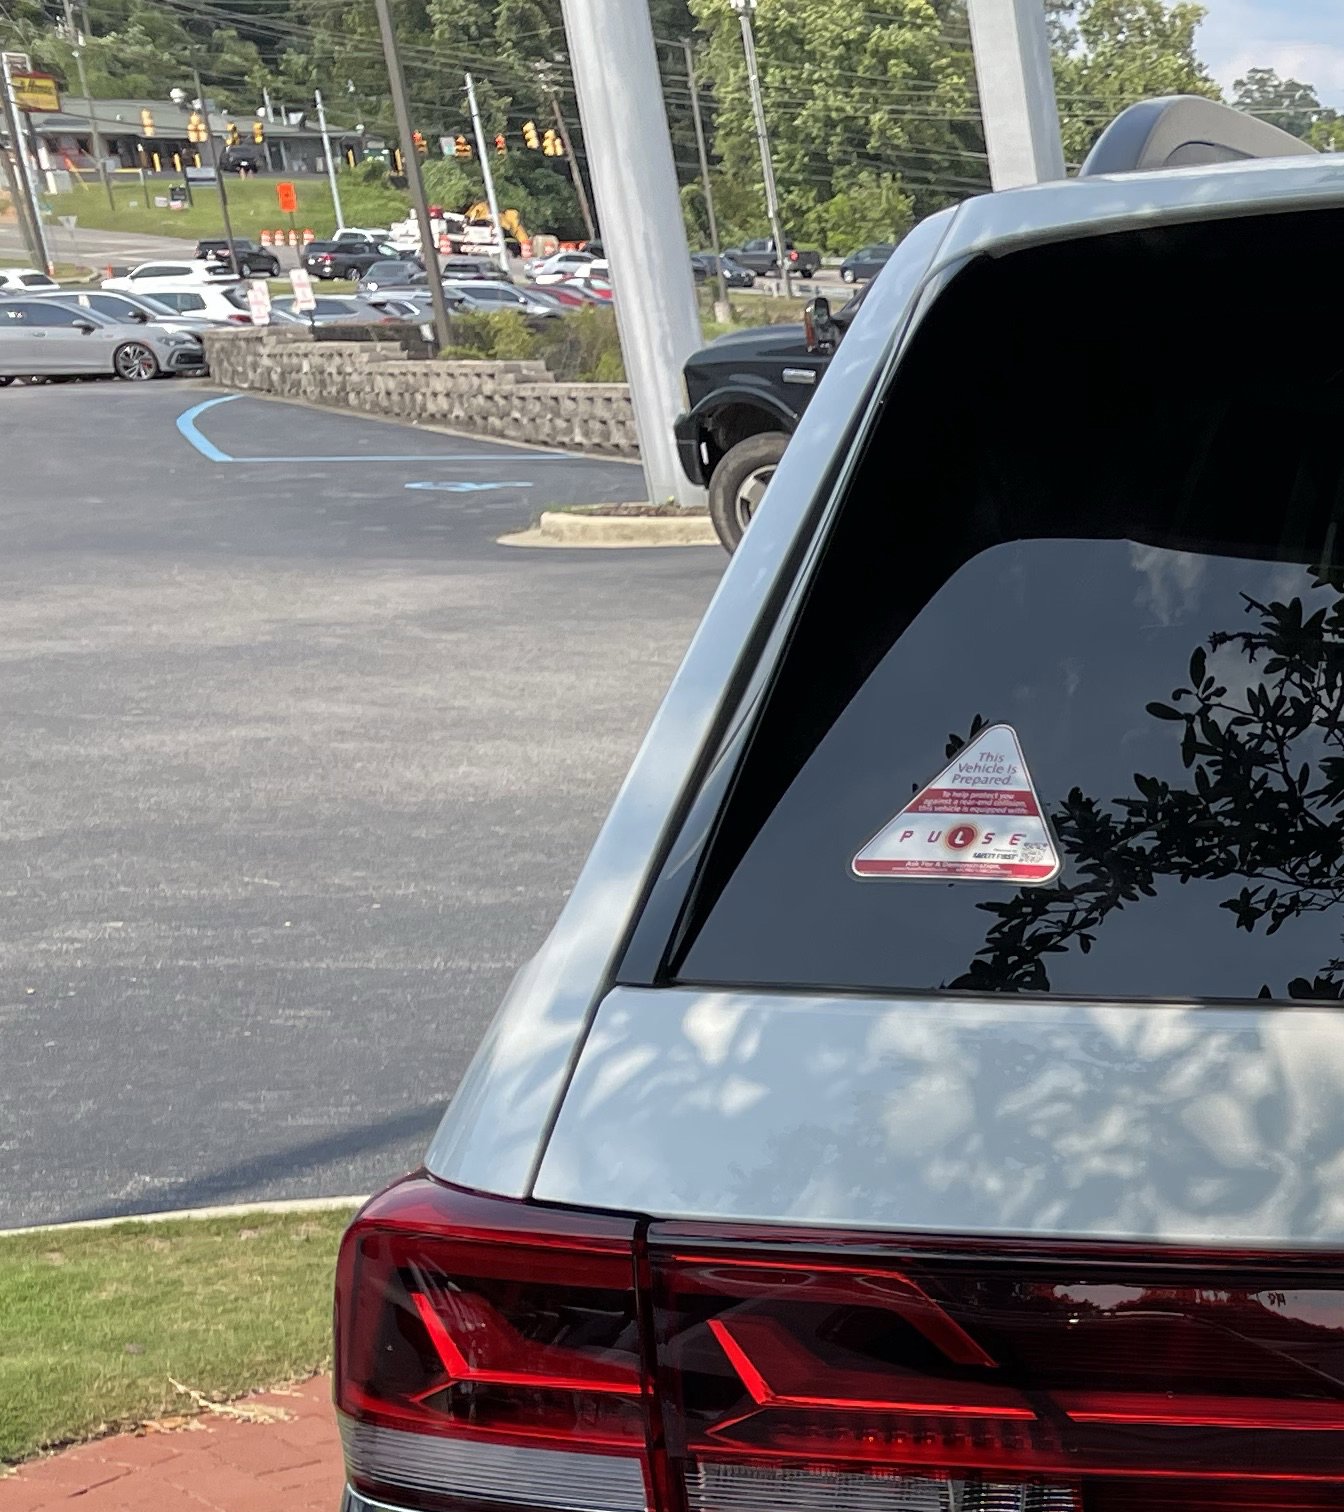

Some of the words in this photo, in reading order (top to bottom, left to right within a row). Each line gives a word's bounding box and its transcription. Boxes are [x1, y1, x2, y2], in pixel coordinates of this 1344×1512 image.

[979, 752, 1005, 762] This
[959, 763, 1005, 774] Vehicle
[1007, 764, 1018, 774] Is
[951, 774, 1013, 787] Prepared.
[899, 830, 1022, 846] PULSE
